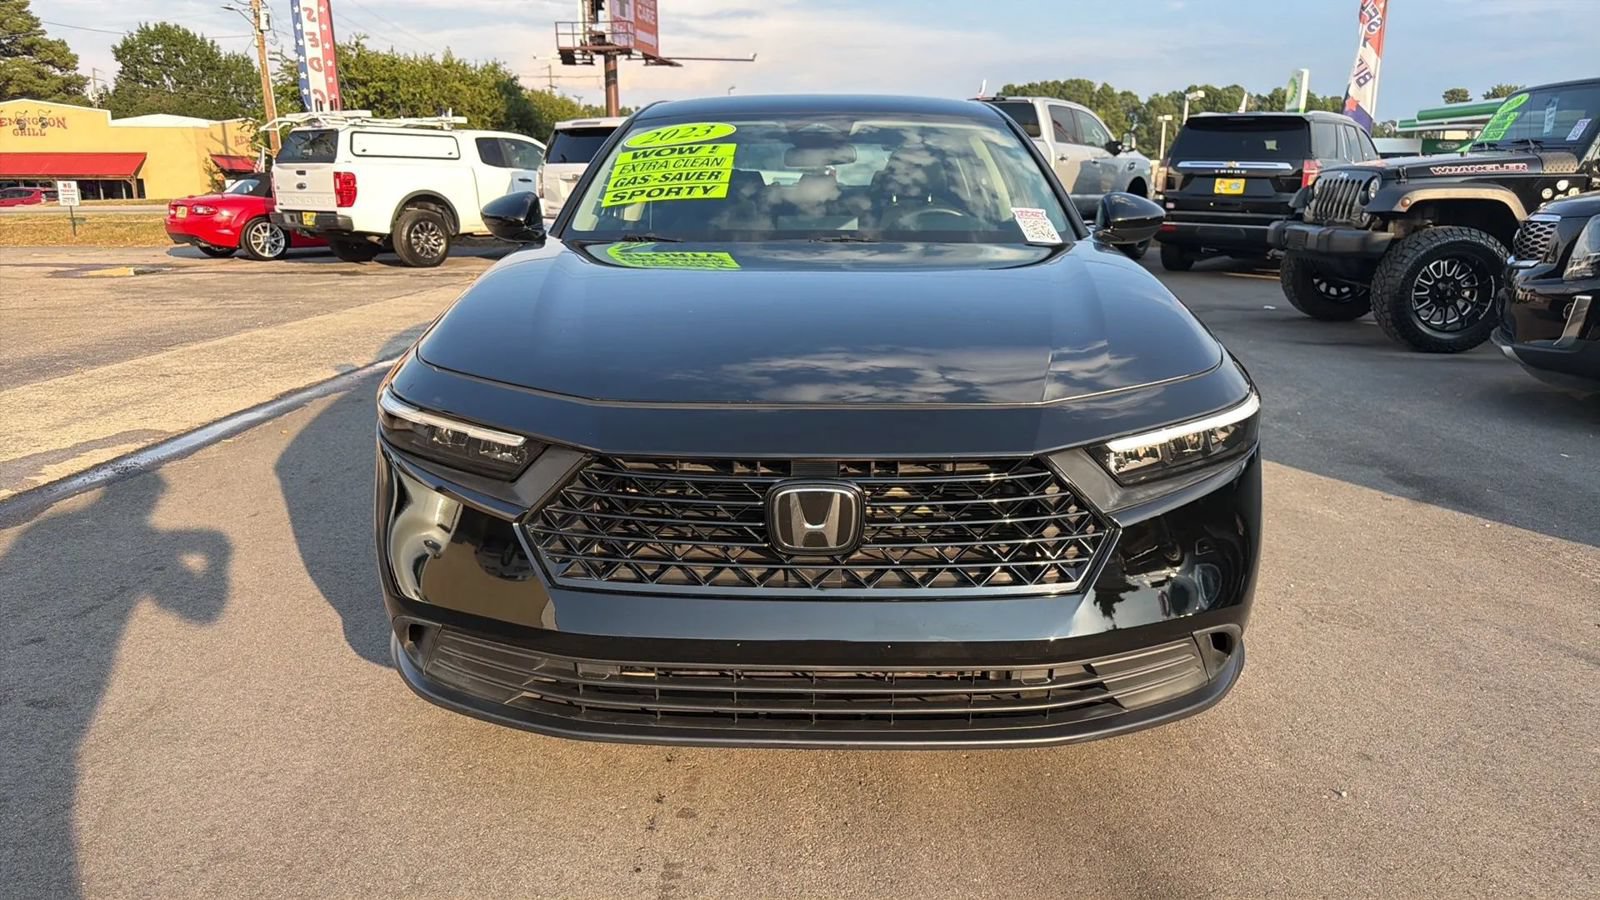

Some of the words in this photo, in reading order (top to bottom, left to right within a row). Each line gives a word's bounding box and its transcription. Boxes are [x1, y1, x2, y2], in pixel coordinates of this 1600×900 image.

[12, 127, 47, 137] GRILL
[640, 125, 716, 145] 2023
[631, 146, 703, 160] WOW
[619, 160, 670, 175] EXTRA
[672, 157, 726, 169] CLEAN
[609, 185, 717, 203] SPORTY
